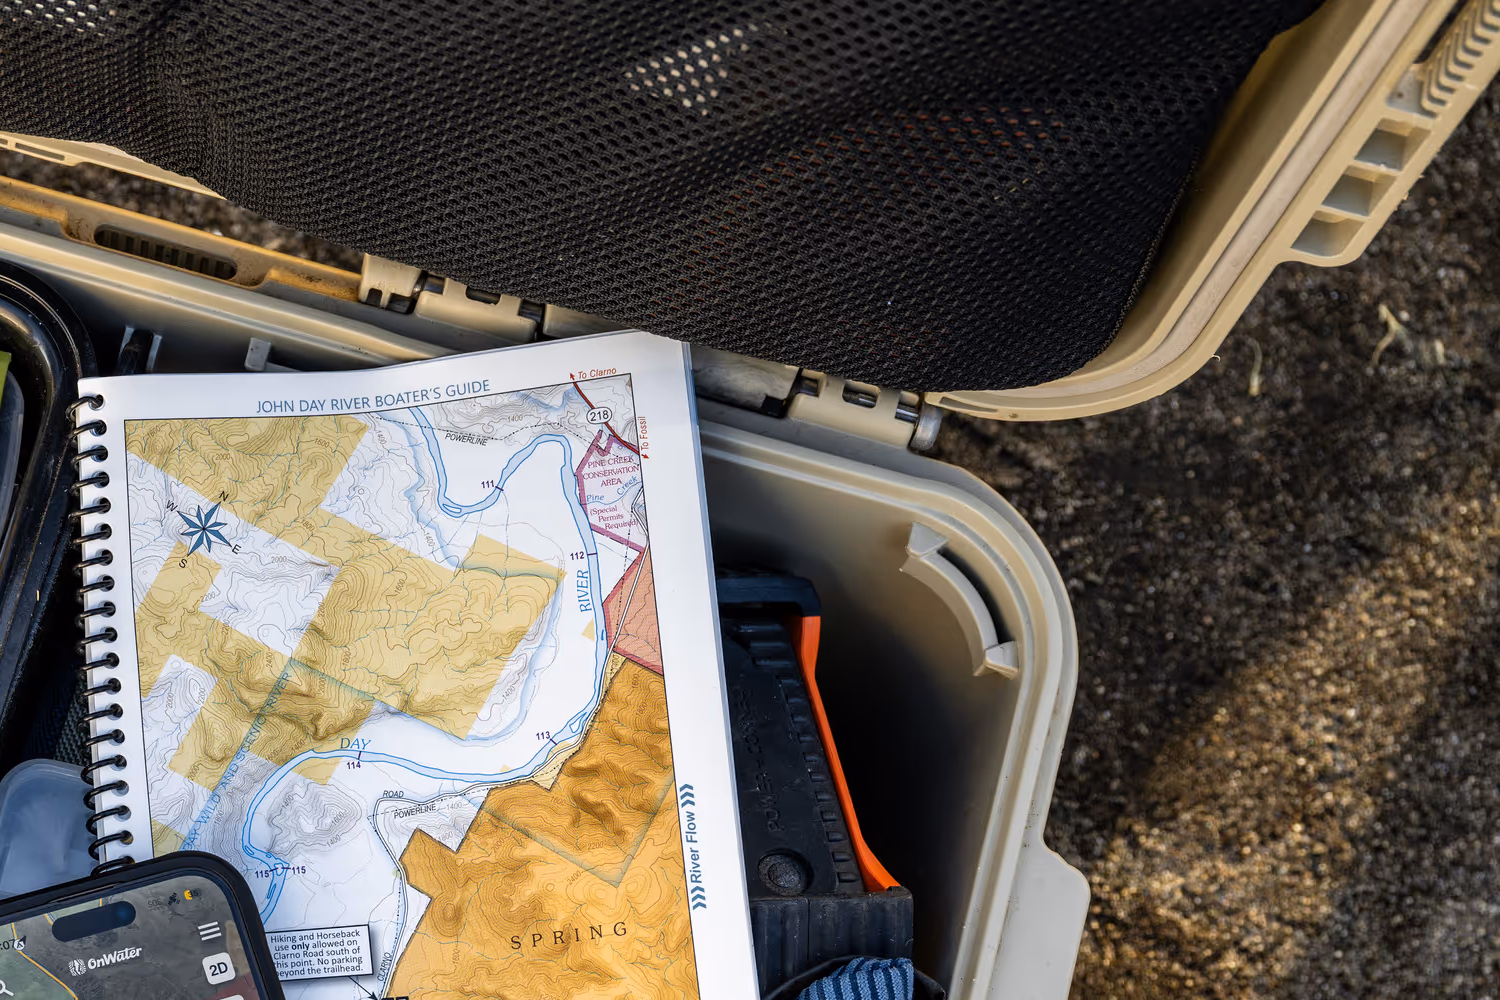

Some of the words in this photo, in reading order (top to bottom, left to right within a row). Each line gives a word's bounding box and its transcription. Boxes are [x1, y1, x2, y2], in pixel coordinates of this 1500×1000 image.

[578, 371, 588, 380] To
[589, 368, 617, 378] Clarno
[257, 400, 295, 414] JOHN
[299, 399, 326, 412] DAY
[331, 396, 371, 411] RIVER
[375, 386, 441, 408] BOATER'S
[445, 379, 491, 398] GUIDE
[589, 410, 609, 422] 218
[639, 416, 648, 440] Fossil
[444, 432, 488, 447] POWERLINE
[640, 441, 649, 451] To
[587, 459, 606, 469] PINE
[607, 455, 635, 466] CREEK
[583, 465, 640, 480] CONSERVATION
[480, 480, 495, 489] 111
[586, 494, 605, 502] Pine
[616, 475, 638, 496] Creek
[600, 478, 623, 487] AREA
[219, 490, 229, 502] N
[166, 500, 178, 512] W
[598, 514, 624, 523] Permits
[231, 544, 242, 555] E
[570, 551, 585, 561] 112
[178, 558, 188, 569] S
[576, 569, 592, 613] RIVER
[535, 731, 551, 741] 113
[200, 792, 222, 825] WILD
[222, 762, 239, 790] AND
[236, 715, 268, 761] SCENIC
[265, 672, 292, 709] RIVER
[340, 737, 371, 750] DAY
[346, 761, 362, 770] 114
[382, 790, 404, 799] ROAD
[393, 803, 437, 819] POWERLINE
[685, 810, 697, 844] Flow
[291, 866, 307, 874] 115
[690, 847, 701, 884] River
[255, 870, 270, 878] 115
[147, 898, 163, 908] SOS
[270, 934, 297, 945] Hiking
[298, 933, 315, 942] and
[316, 929, 361, 940] Horseback
[510, 921, 627, 950] SPRING
[274, 943, 289, 952] use
[291, 942, 310, 951] only
[311, 939, 345, 949] allowed
[87, 946, 143, 970] OnWater
[272, 951, 301, 961] Clarno
[302, 949, 324, 958] Road
[325, 947, 350, 956] south
[351, 946, 361, 955] of
[290, 959, 315, 969] point.
[317, 957, 330, 966] No
[332, 955, 363, 966] parking
[377, 951, 391, 982] CLARNO
[208, 961, 229, 977] 2D
[307, 966, 322, 975] the
[323, 963, 364, 974] trailhead.
